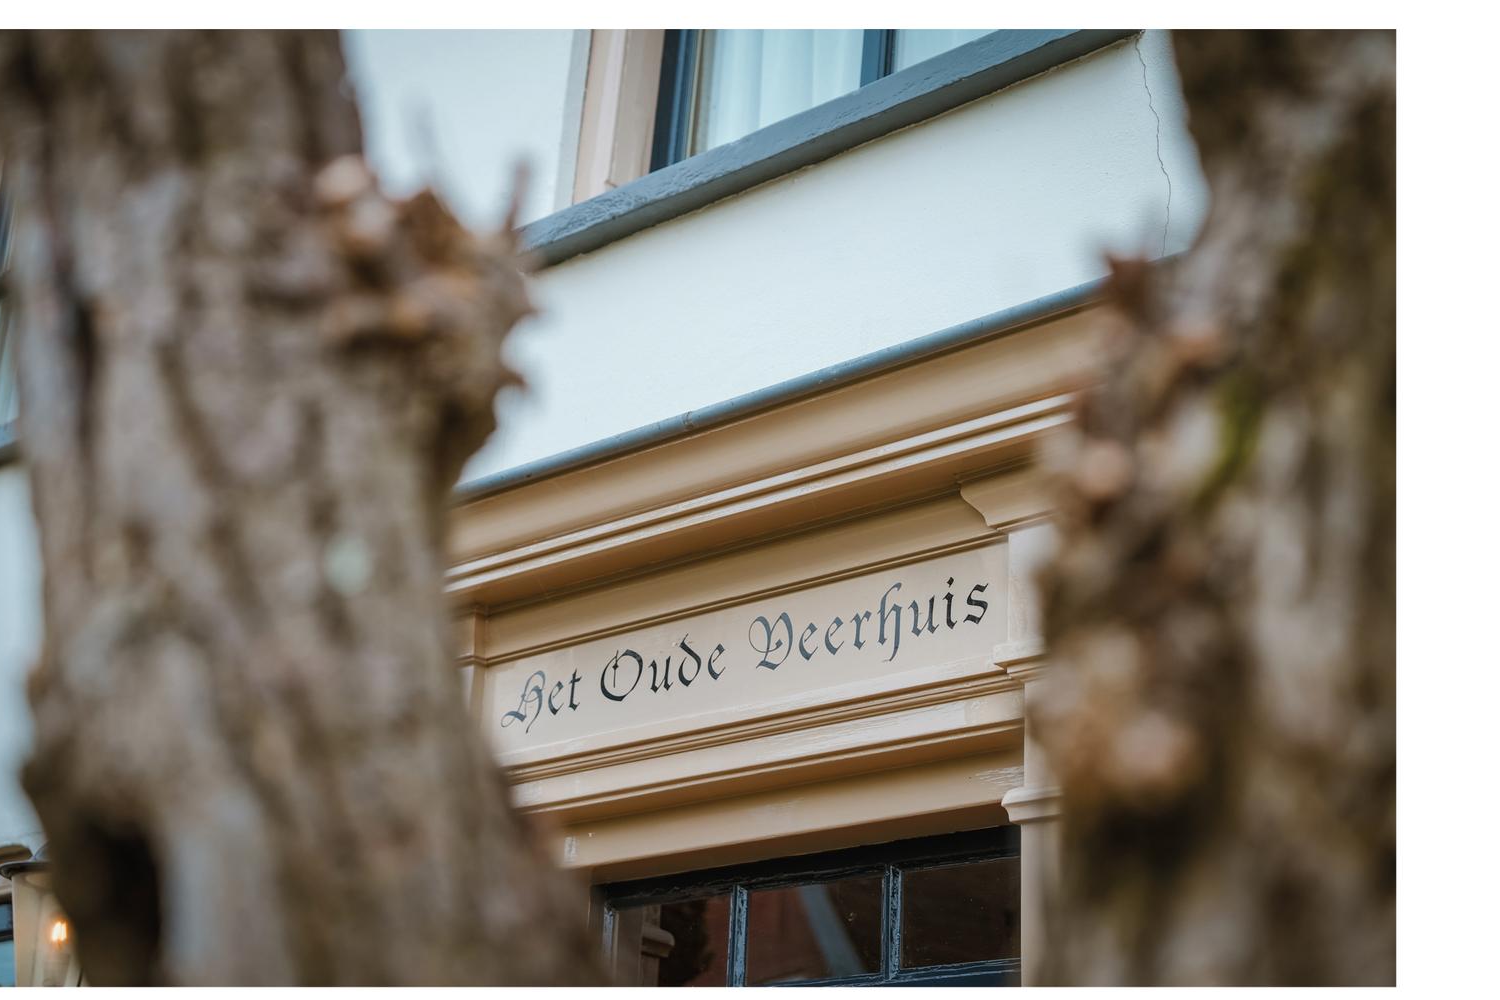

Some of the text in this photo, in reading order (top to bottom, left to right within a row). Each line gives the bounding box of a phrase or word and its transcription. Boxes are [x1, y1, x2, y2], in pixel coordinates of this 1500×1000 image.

[500, 576, 990, 734] Het Oude Veerhuis
